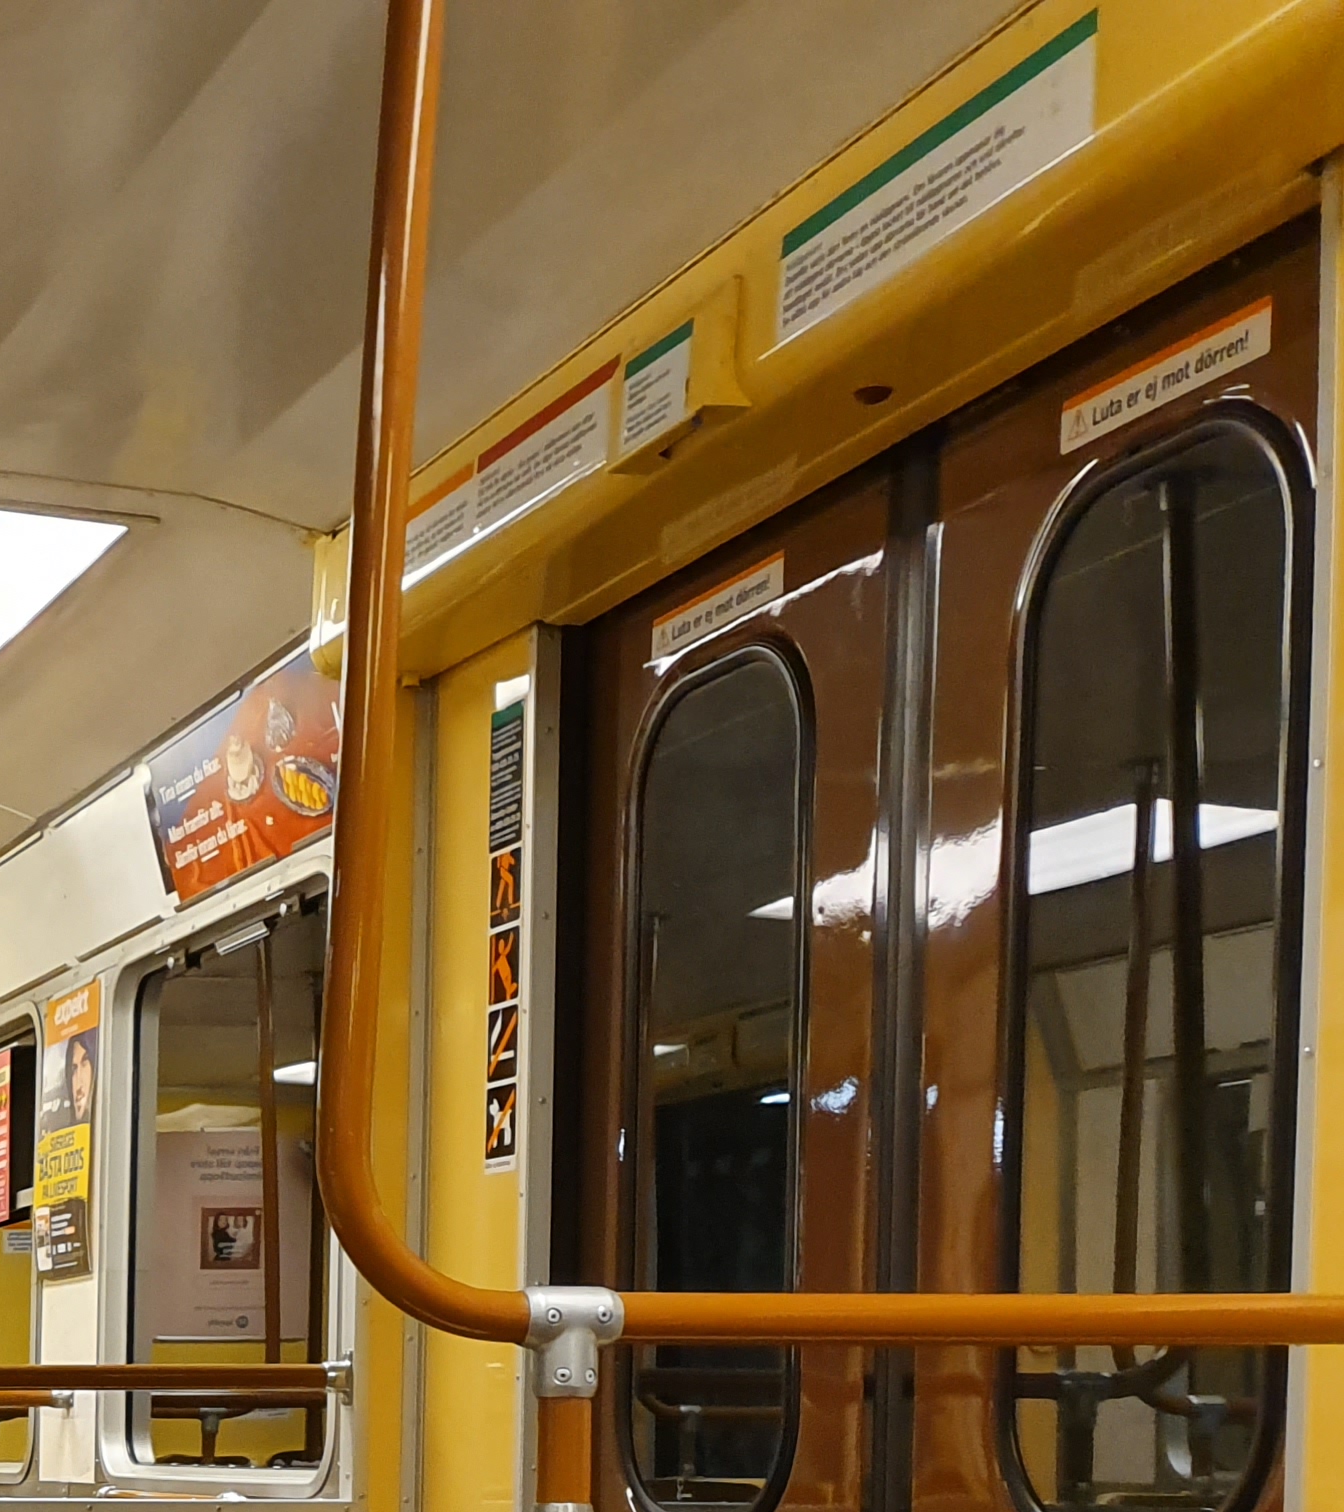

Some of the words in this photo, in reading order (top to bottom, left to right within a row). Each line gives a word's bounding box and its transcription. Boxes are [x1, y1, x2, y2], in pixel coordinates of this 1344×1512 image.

[1092, 398, 1122, 426] Luta
[1126, 390, 1141, 409] er
[1145, 376, 1157, 401] ej
[1162, 362, 1190, 391] mot
[1195, 329, 1249, 374] dörren!
[671, 620, 691, 641] Luta
[693, 614, 703, 628] er
[705, 605, 714, 624] ej
[715, 595, 734, 616] mot
[736, 573, 770, 606] dörren!
